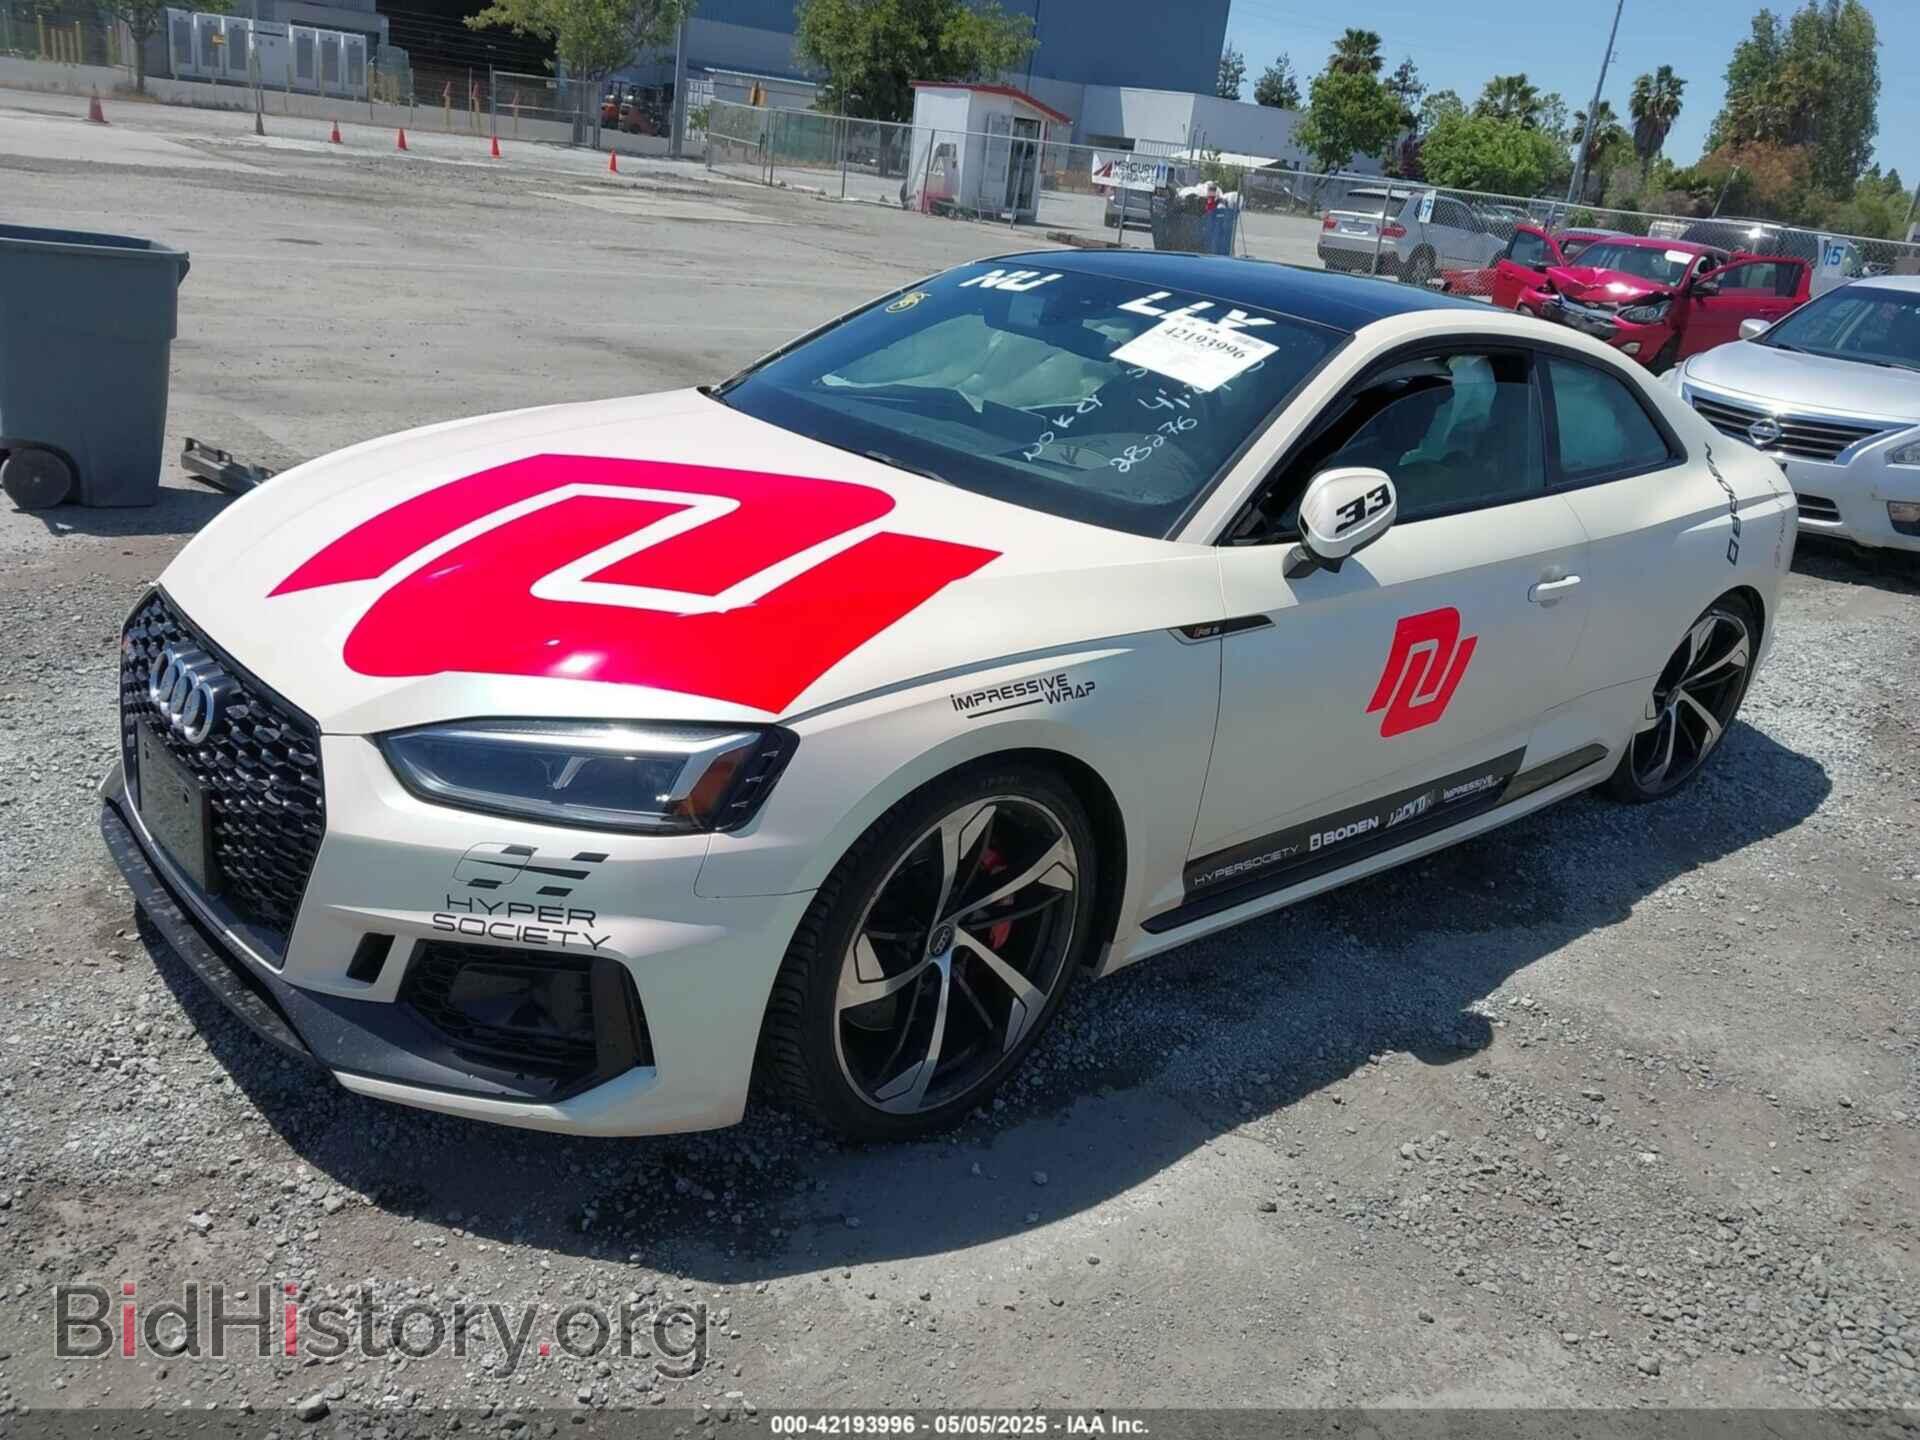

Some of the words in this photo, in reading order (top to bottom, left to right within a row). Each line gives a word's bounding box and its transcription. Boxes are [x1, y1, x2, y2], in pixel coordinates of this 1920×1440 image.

[1163, 326, 1246, 360] 42193996
[1110, 415, 1198, 473] 28276
[1335, 483, 1393, 534] 33
[1044, 681, 1096, 704] WRAP
[1323, 815, 1379, 846] BODEN
[446, 893, 597, 928] HYPER
[432, 912, 612, 951] SOCIETY
